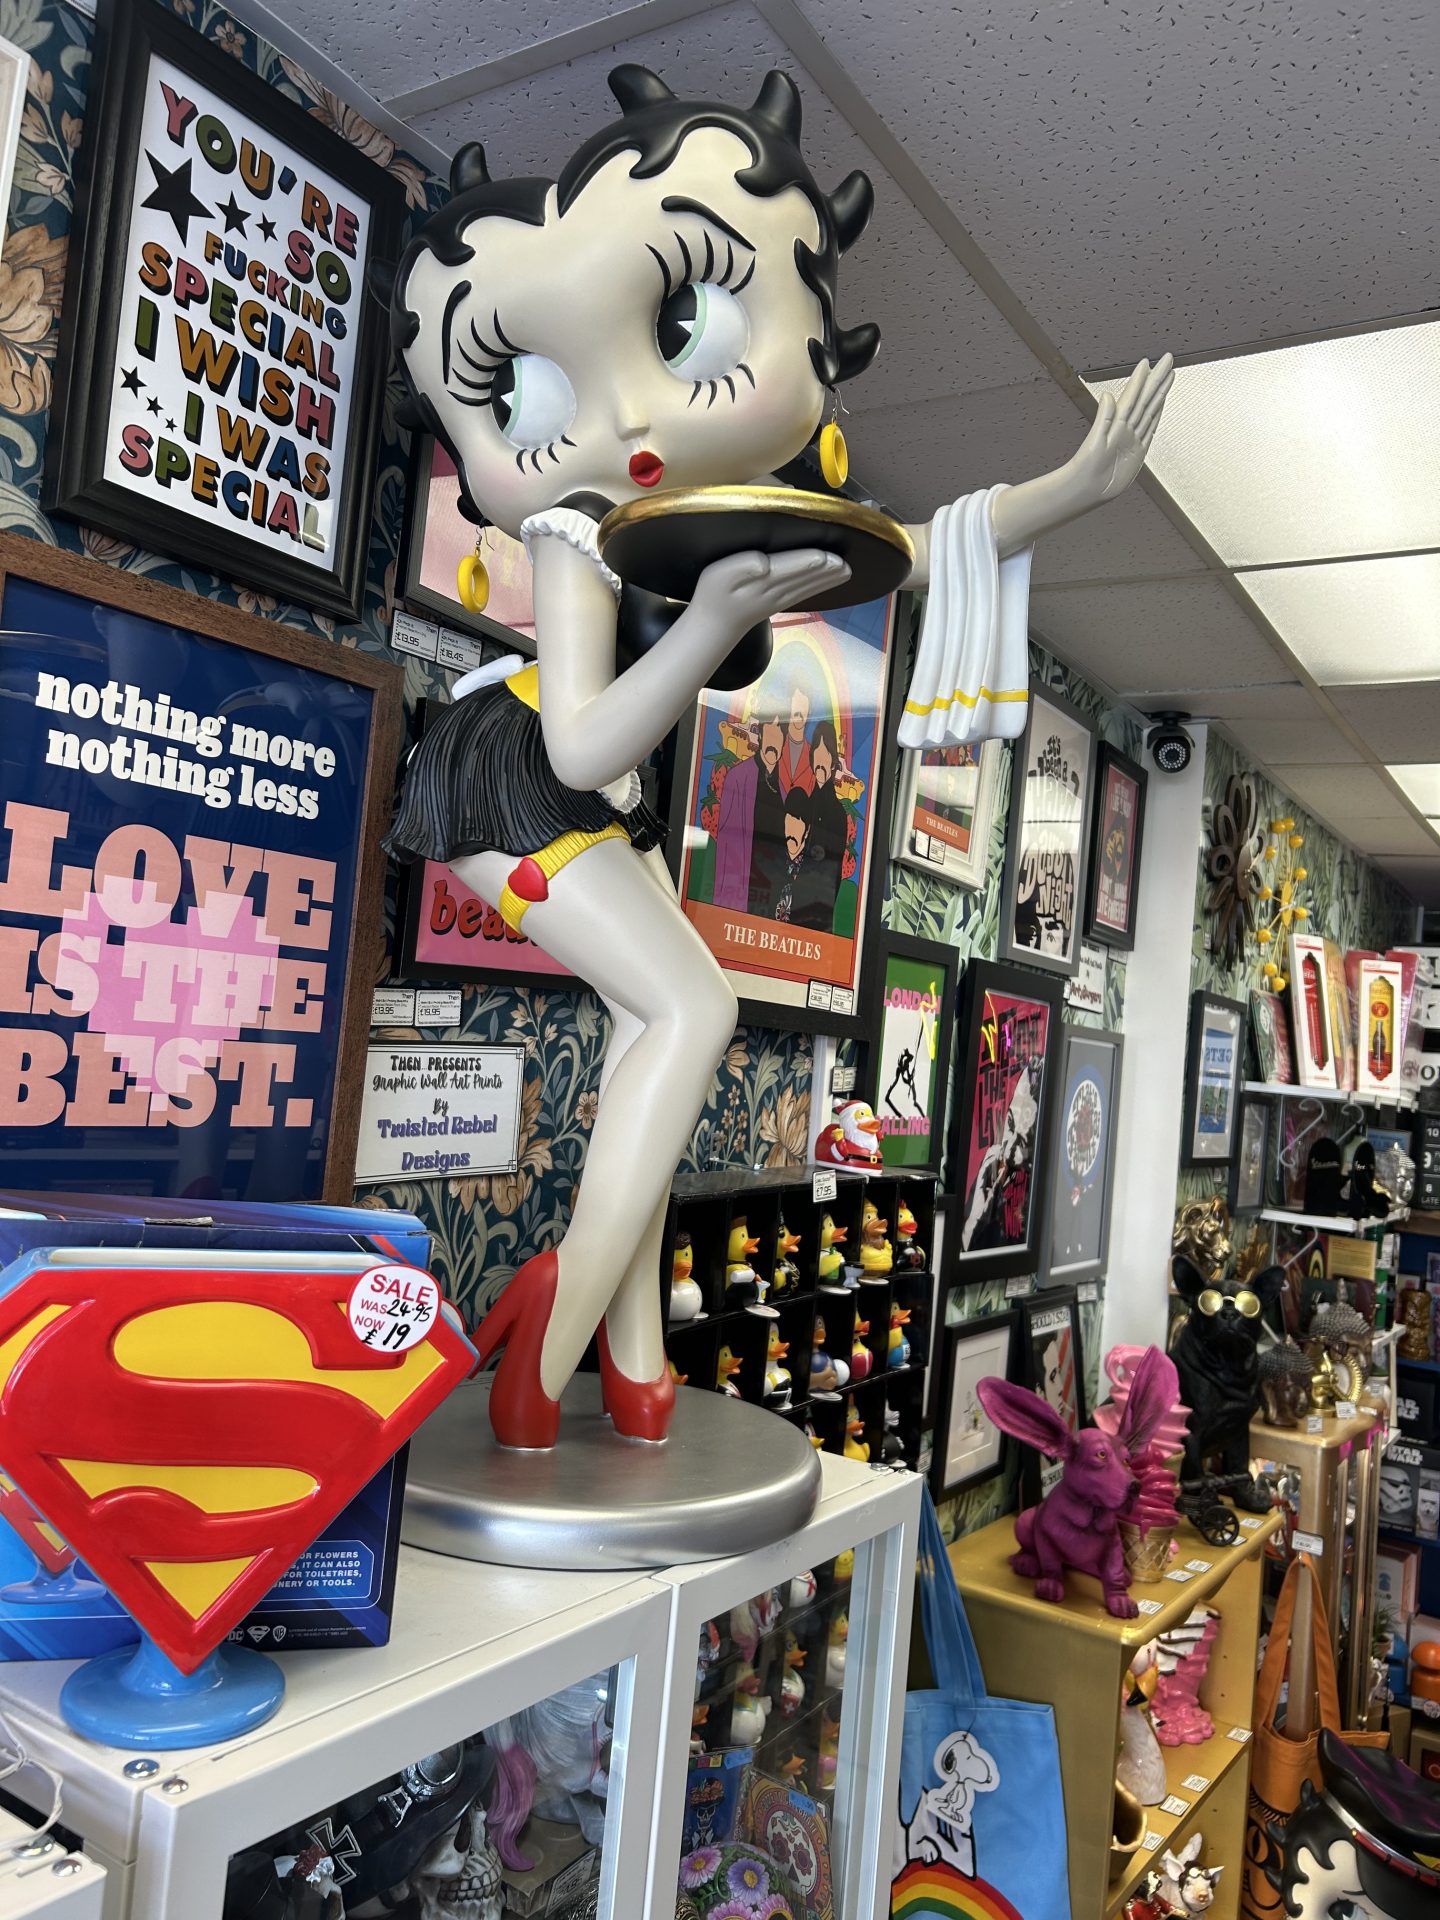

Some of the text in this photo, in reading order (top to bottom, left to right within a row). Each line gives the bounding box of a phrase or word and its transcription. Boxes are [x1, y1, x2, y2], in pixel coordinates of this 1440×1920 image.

[159, 80, 359, 260] YOU'RE
[285, 229, 351, 304] SO
[204, 231, 347, 340] FUCKING
[139, 241, 340, 391] SPECIAL
[134, 295, 335, 449] I WISH
[184, 390, 331, 501] I WAS
[119, 423, 325, 553] SPECIAL
[396, 632, 419, 646] £13.95
[441, 648, 463, 662] £18.45
[35, 672, 335, 778] nothing more
[45, 727, 319, 820] nothing less
[926, 816, 958, 838] THE BEATLES
[0, 802, 337, 951] LOVE
[724, 923, 821, 960] THE BEATLES
[0, 925, 326, 1033] IS THE
[374, 1007, 394, 1015] £13.95
[884, 986, 941, 1015] LONDON
[0, 1027, 313, 1127] BEST.
[420, 1072, 448, 1089] Wall
[450, 1073, 471, 1090] Art
[473, 1073, 503, 1090] Prints
[433, 1098, 449, 1117] By
[378, 1114, 498, 1138] Twisted Rebel
[876, 1114, 930, 1136] ALLING
[402, 1150, 471, 1173] Designs
[370, 1274, 433, 1305] SALE
[361, 1298, 388, 1314] WAS
[354, 1315, 385, 1330] NOW
[302, 1561, 312, 1569] IT
[336, 1560, 361, 1568] ALSO
[315, 1551, 359, 1559] FLOWERS
[305, 1569, 362, 1578] TOILETRIES,
[322, 1578, 356, 1587] TOOLS.
